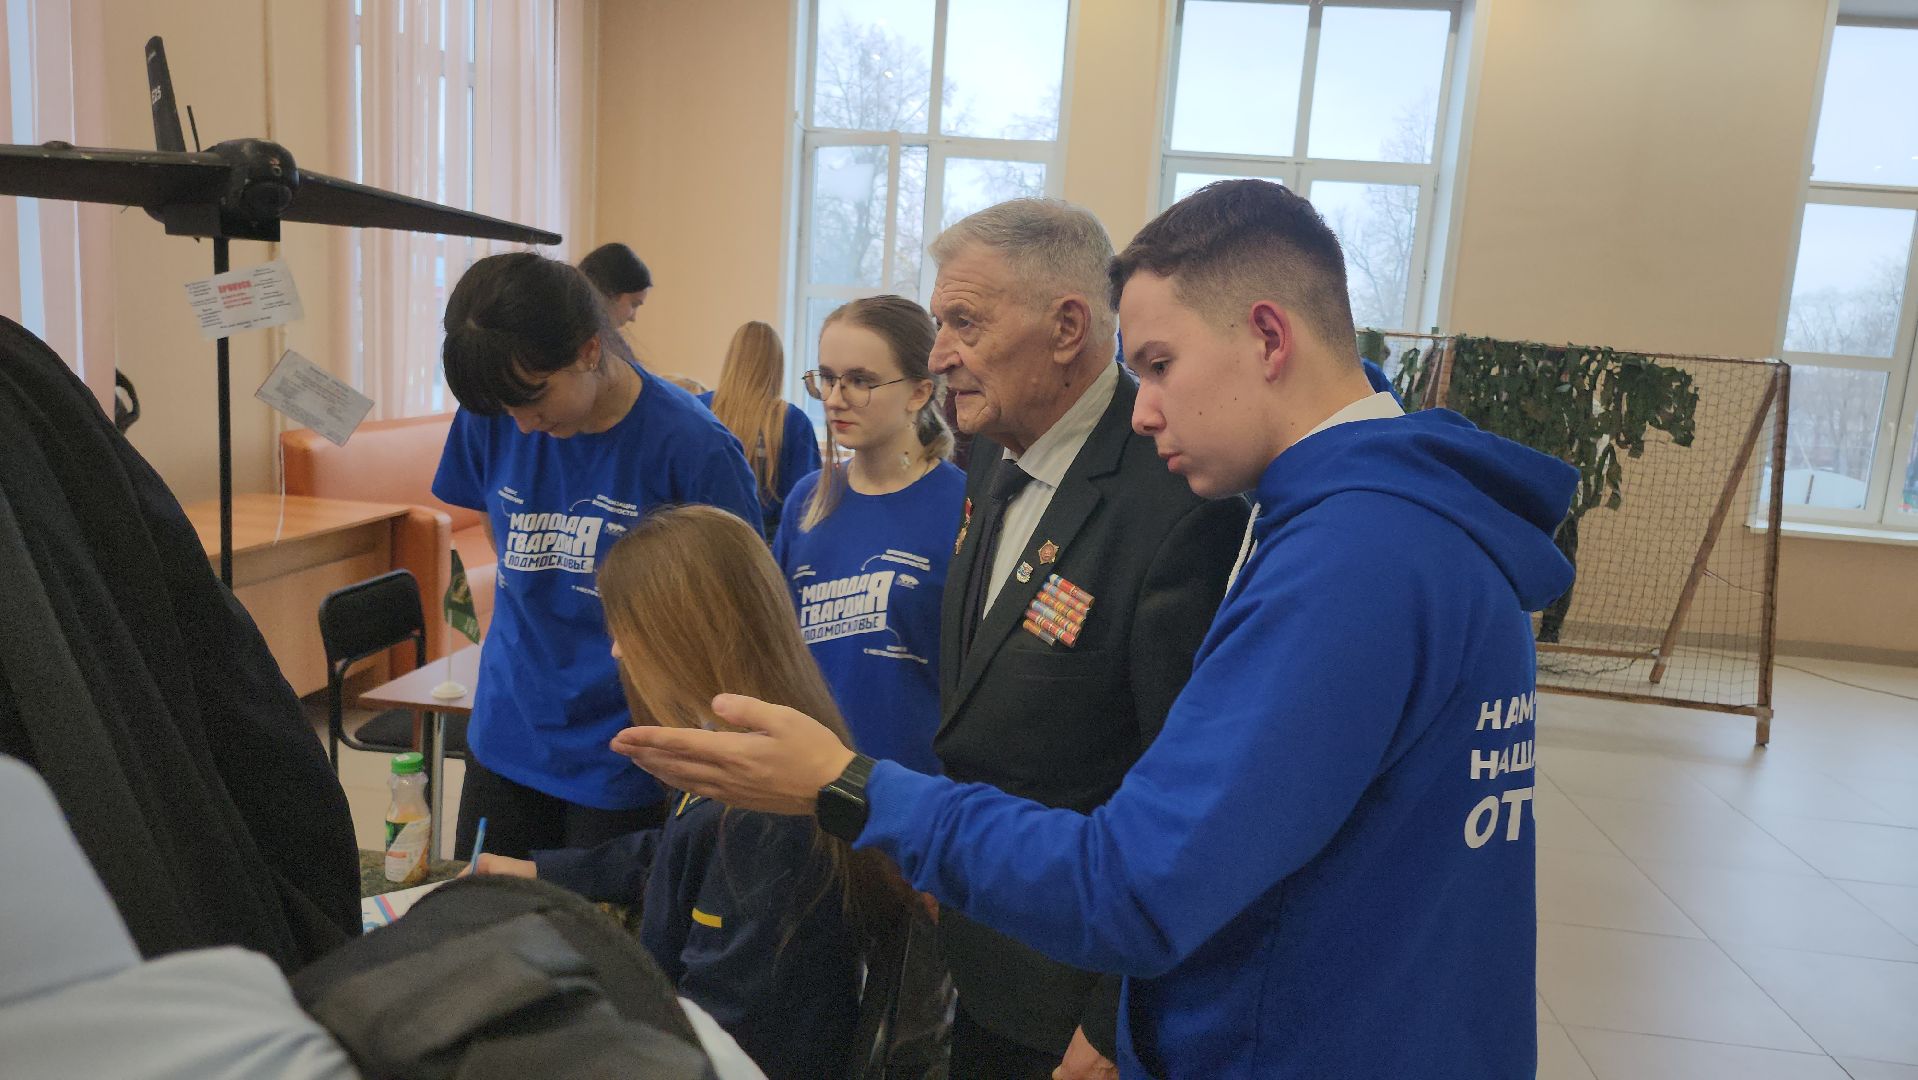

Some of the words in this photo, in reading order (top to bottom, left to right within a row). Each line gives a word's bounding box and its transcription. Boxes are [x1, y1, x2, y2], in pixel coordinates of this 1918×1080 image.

[508, 554, 587, 570] ПОДМОСКОВЬЕ
[801, 570, 896, 605] МОЛОДАЯ
[800, 592, 893, 627] ГВАРДИЯ
[1475, 690, 1536, 731] НАМ
[1470, 739, 1536, 780] НАШ
[1464, 786, 1536, 849] ОТ
